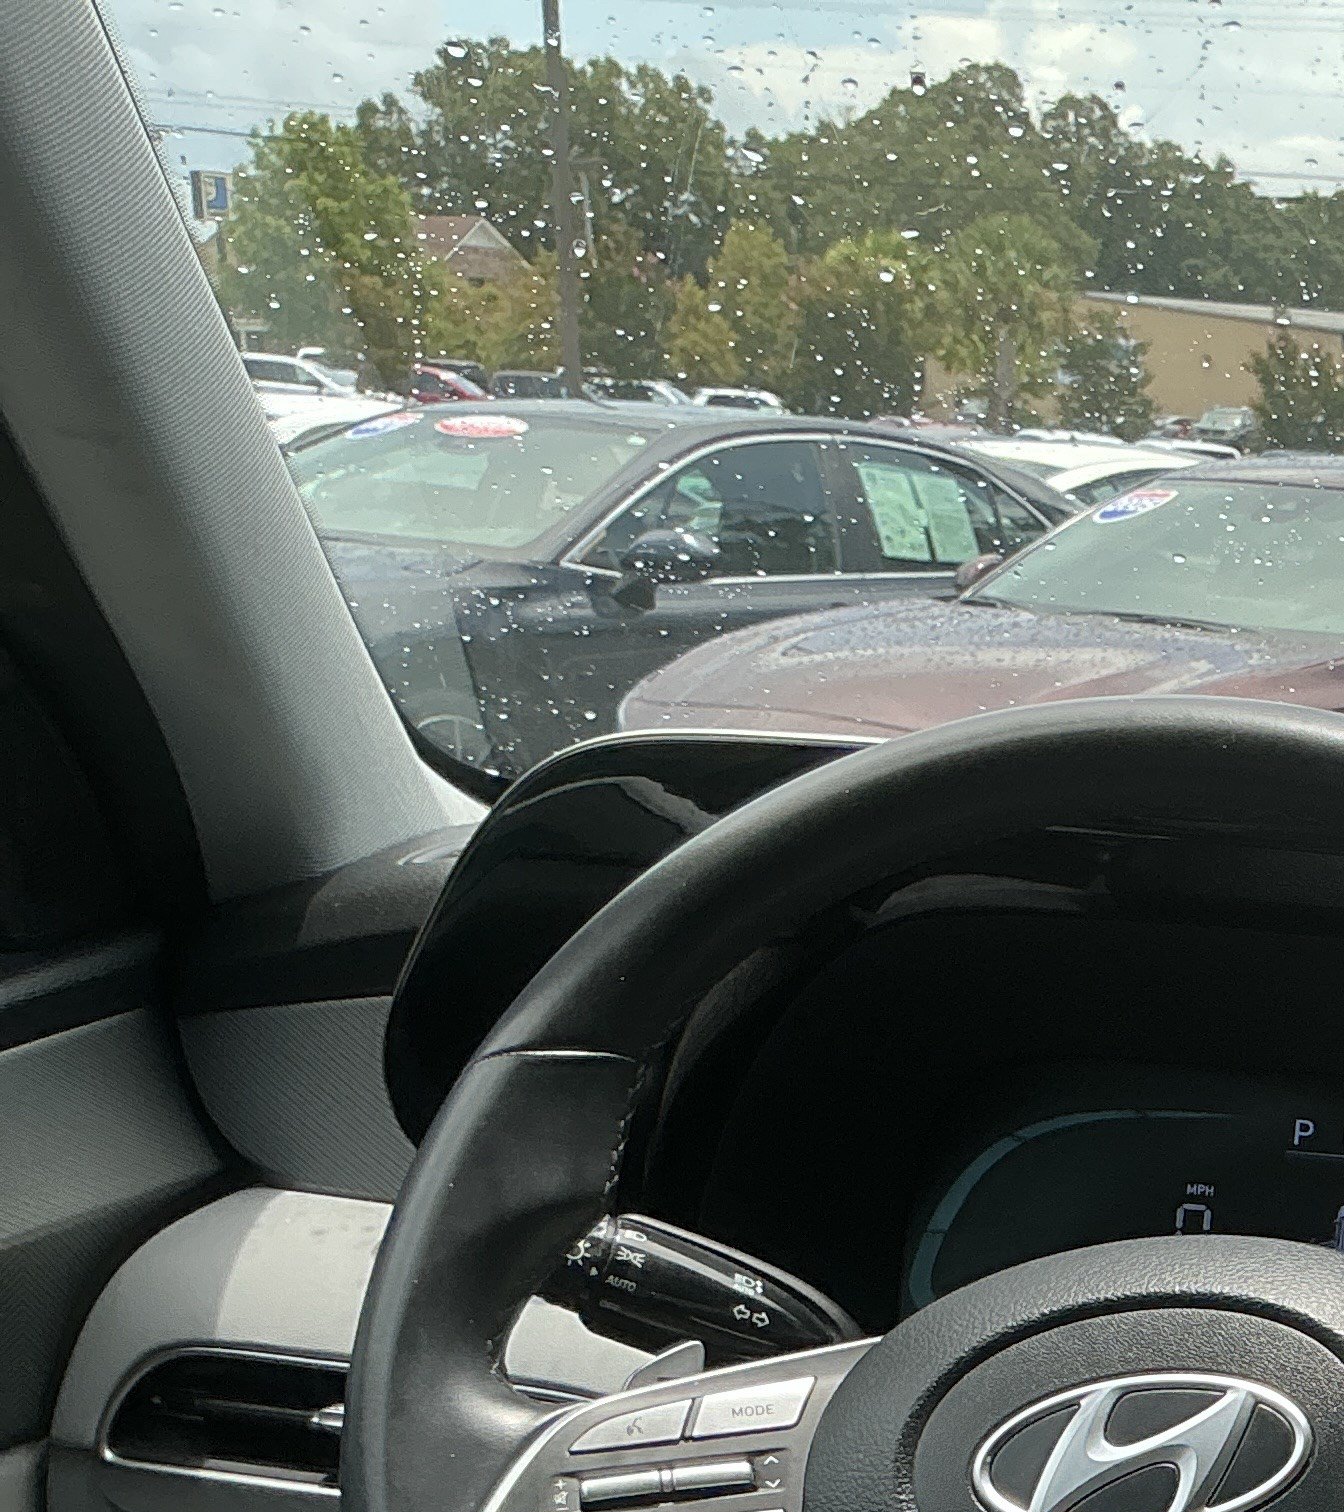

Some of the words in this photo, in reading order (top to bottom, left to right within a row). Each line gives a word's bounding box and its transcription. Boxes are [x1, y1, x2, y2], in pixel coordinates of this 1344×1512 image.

[1293, 1118, 1315, 1146] P
[1186, 1182, 1215, 1197] MPH
[603, 1273, 638, 1293] AUTO
[731, 1403, 777, 1419] MODE
